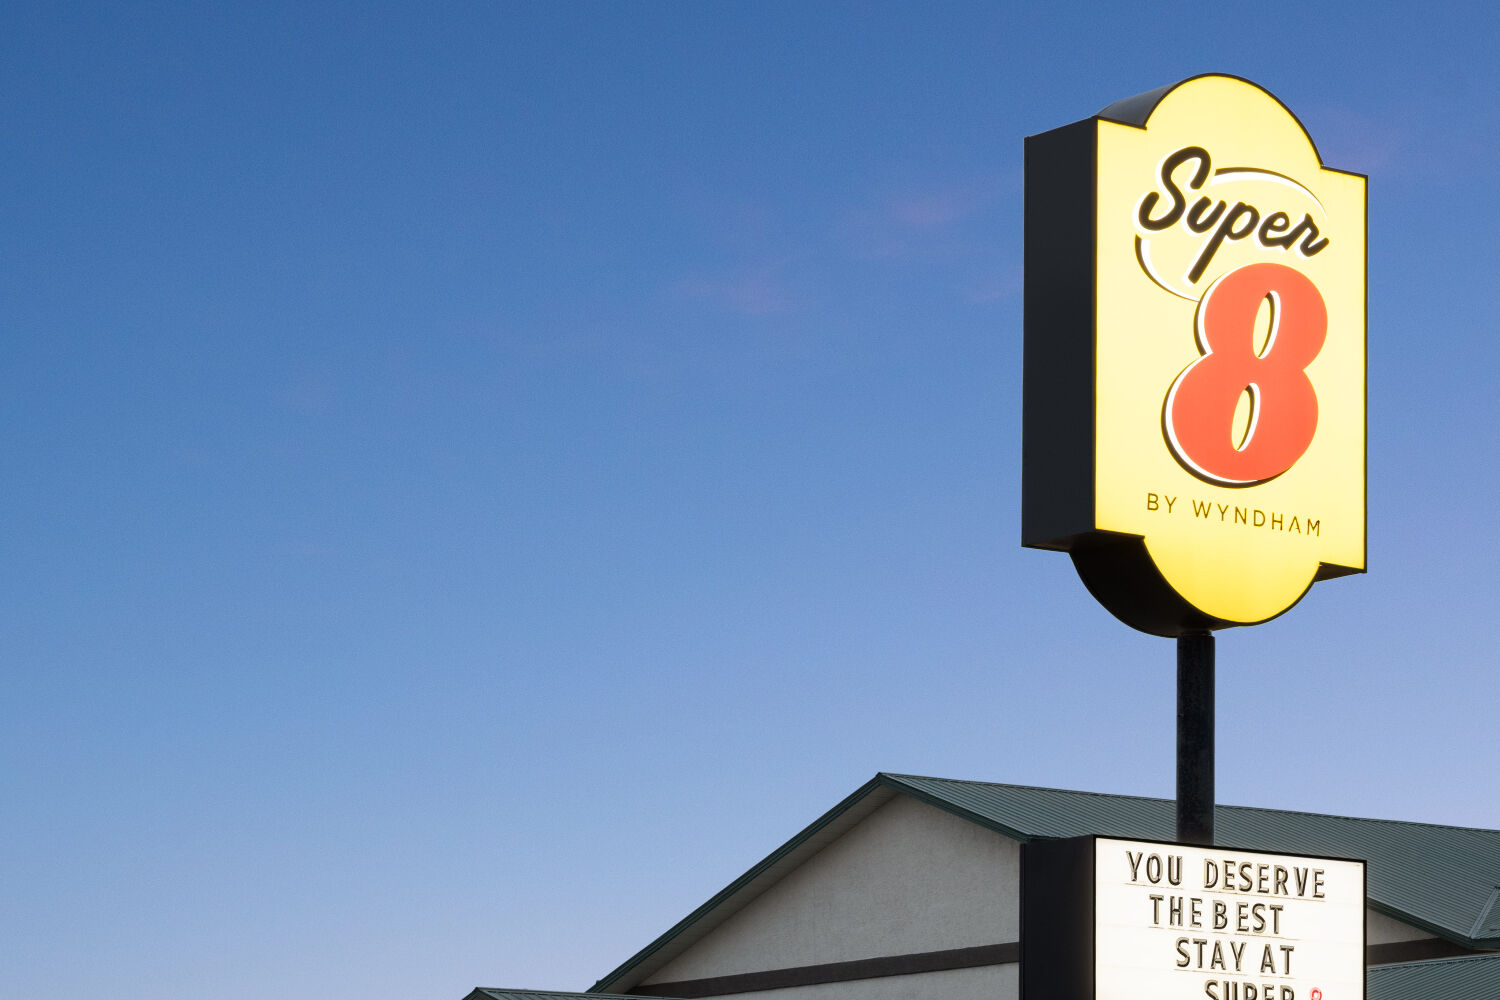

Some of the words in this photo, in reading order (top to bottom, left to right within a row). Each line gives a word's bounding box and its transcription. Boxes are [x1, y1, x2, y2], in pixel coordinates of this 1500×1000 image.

[1138, 145, 1329, 284] Super
[1162, 262, 1329, 488] 8
[1146, 492, 1177, 514] BY
[1192, 499, 1321, 537] WYNDHAM
[1125, 851, 1183, 886] YOU
[1203, 858, 1325, 898] DESERVE
[1149, 894, 1203, 928] THE
[1212, 900, 1284, 934] BEST
[1175, 937, 1247, 971] STAY
[1260, 944, 1295, 975] AT
